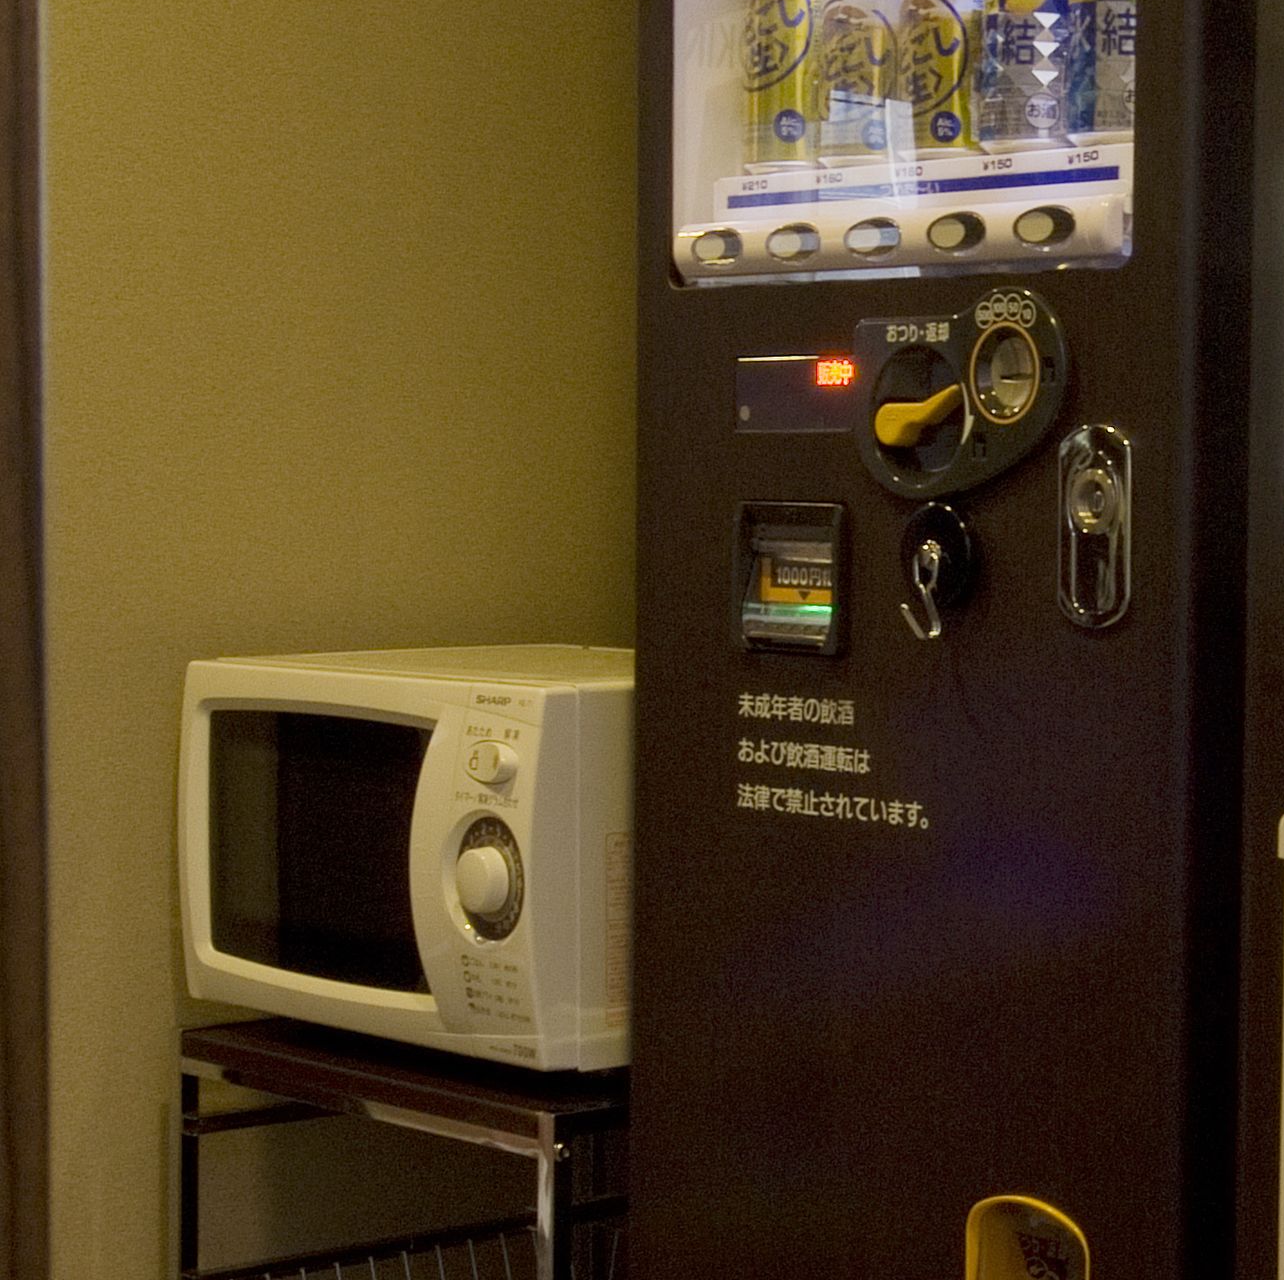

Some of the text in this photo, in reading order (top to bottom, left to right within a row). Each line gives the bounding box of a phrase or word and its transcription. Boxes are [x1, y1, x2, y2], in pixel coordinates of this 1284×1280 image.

[475, 694, 512, 707] SHARP
[738, 692, 855, 726] 未成年者の飲酒
[737, 737, 871, 774] および飲酒運転は
[737, 783, 930, 829] 法律で禁止されています。
